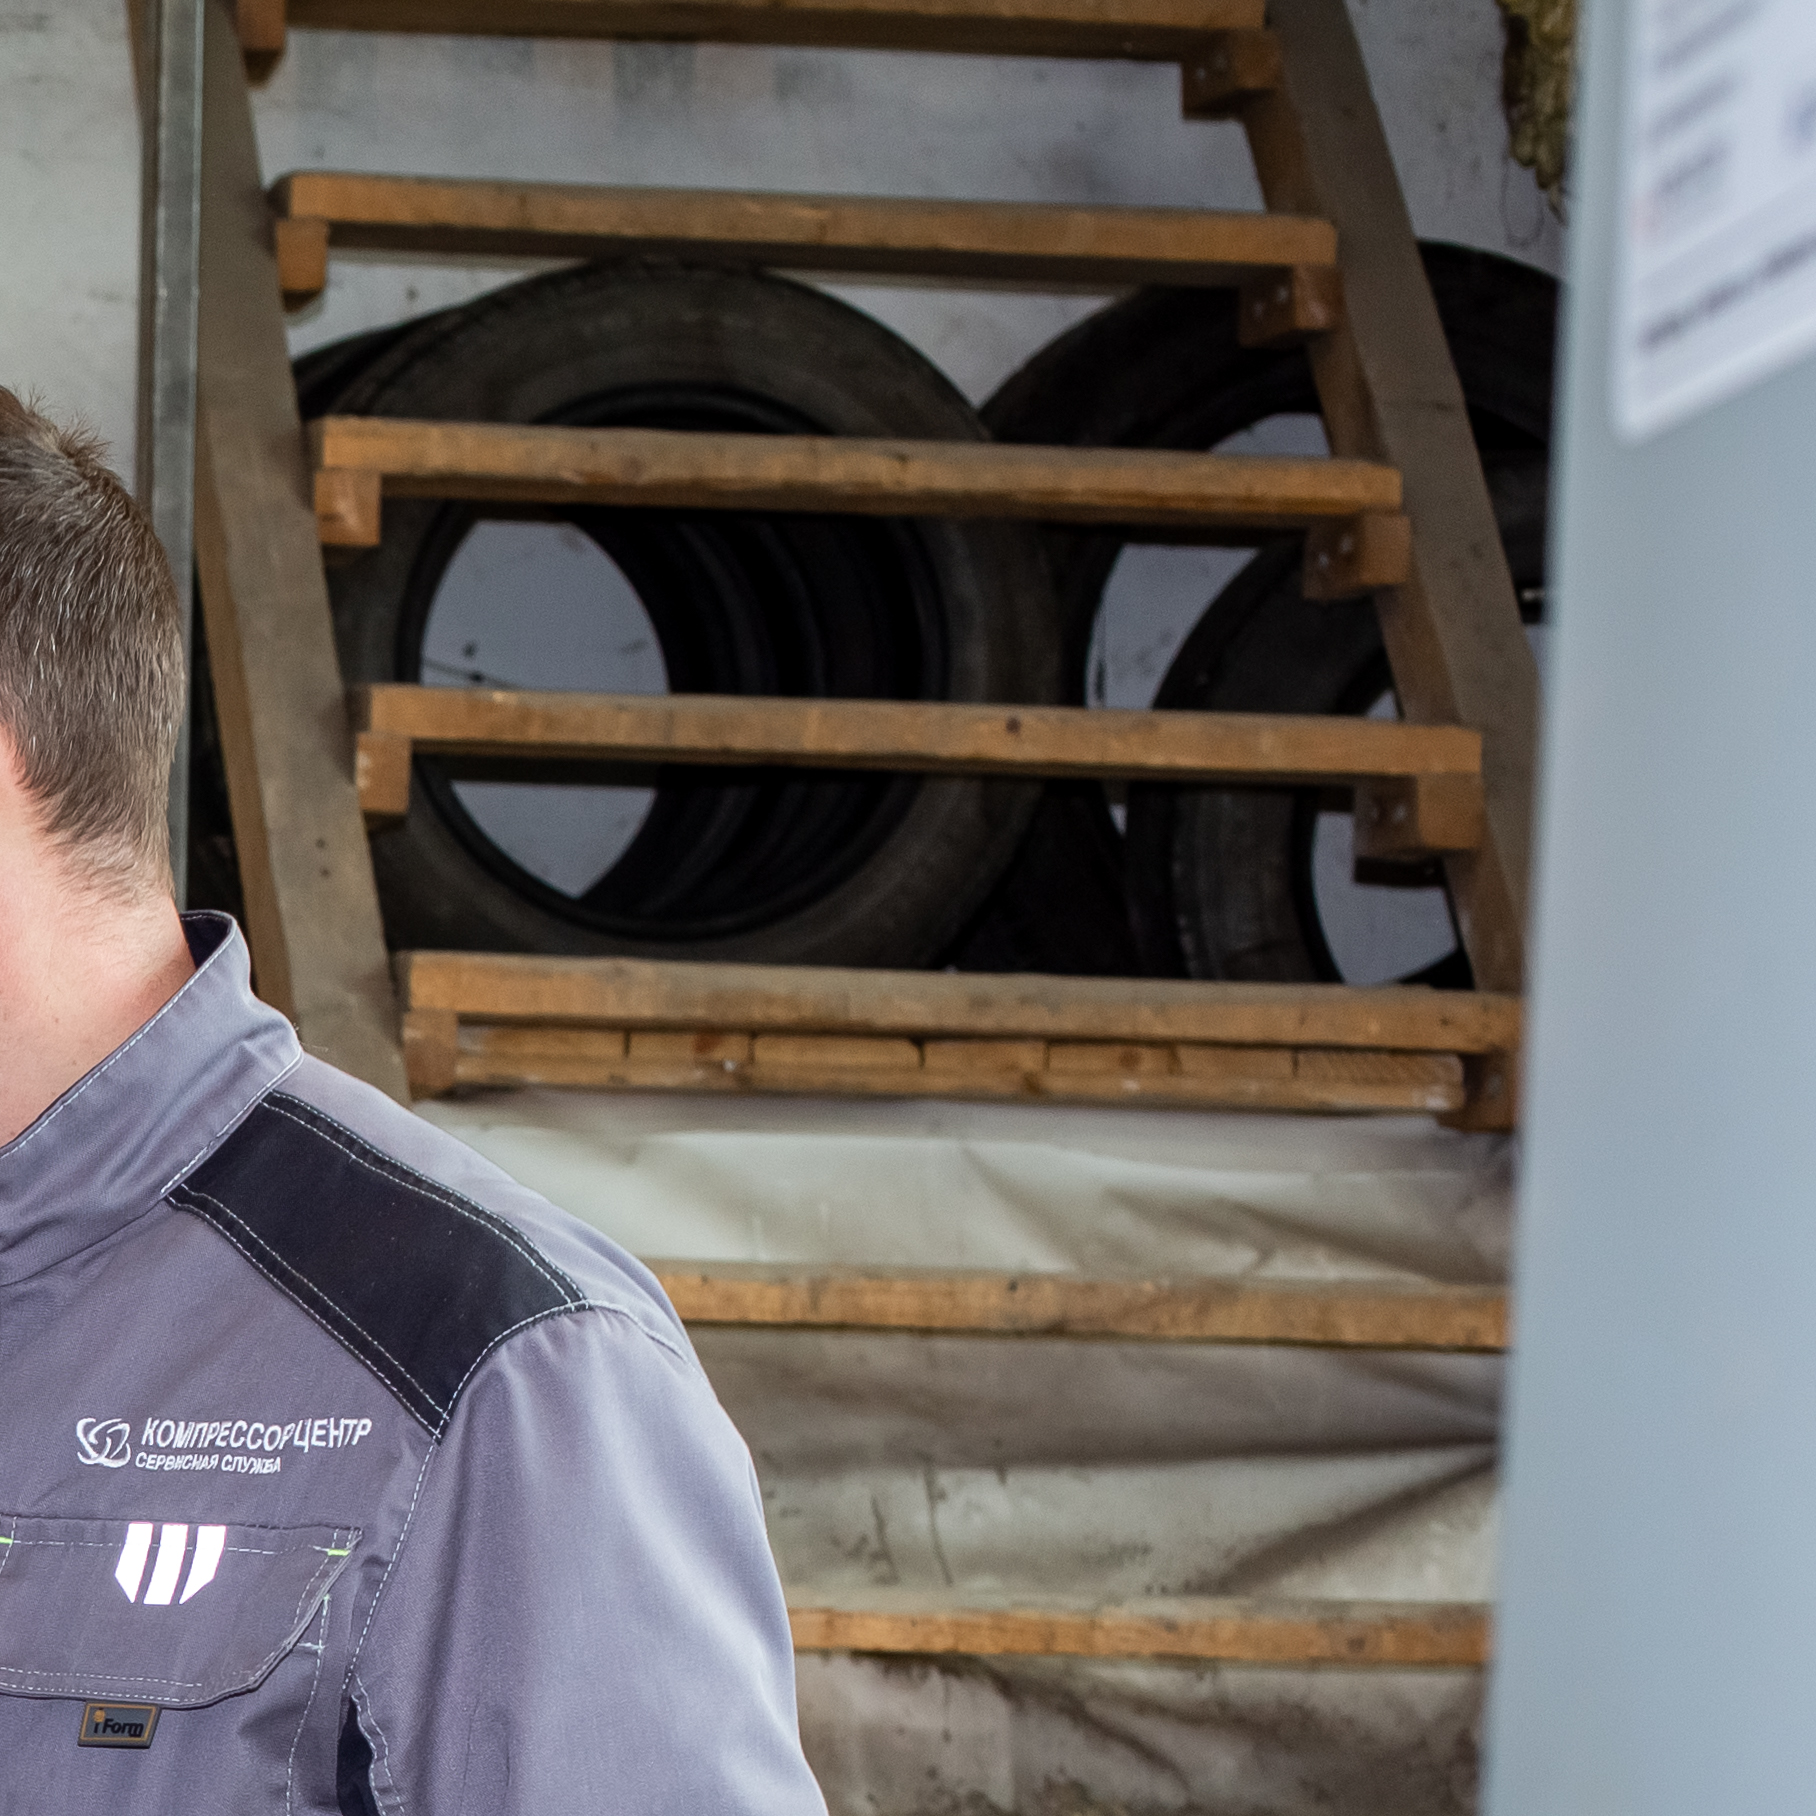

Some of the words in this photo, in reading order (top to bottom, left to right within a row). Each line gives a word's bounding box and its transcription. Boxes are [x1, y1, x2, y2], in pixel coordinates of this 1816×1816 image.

[141, 1417, 372, 1453] КОМПРЕССОРЦЕНТР
[135, 1451, 219, 1471] СЕРВИСНАЯ
[221, 1454, 281, 1475] СЛУЖБА
